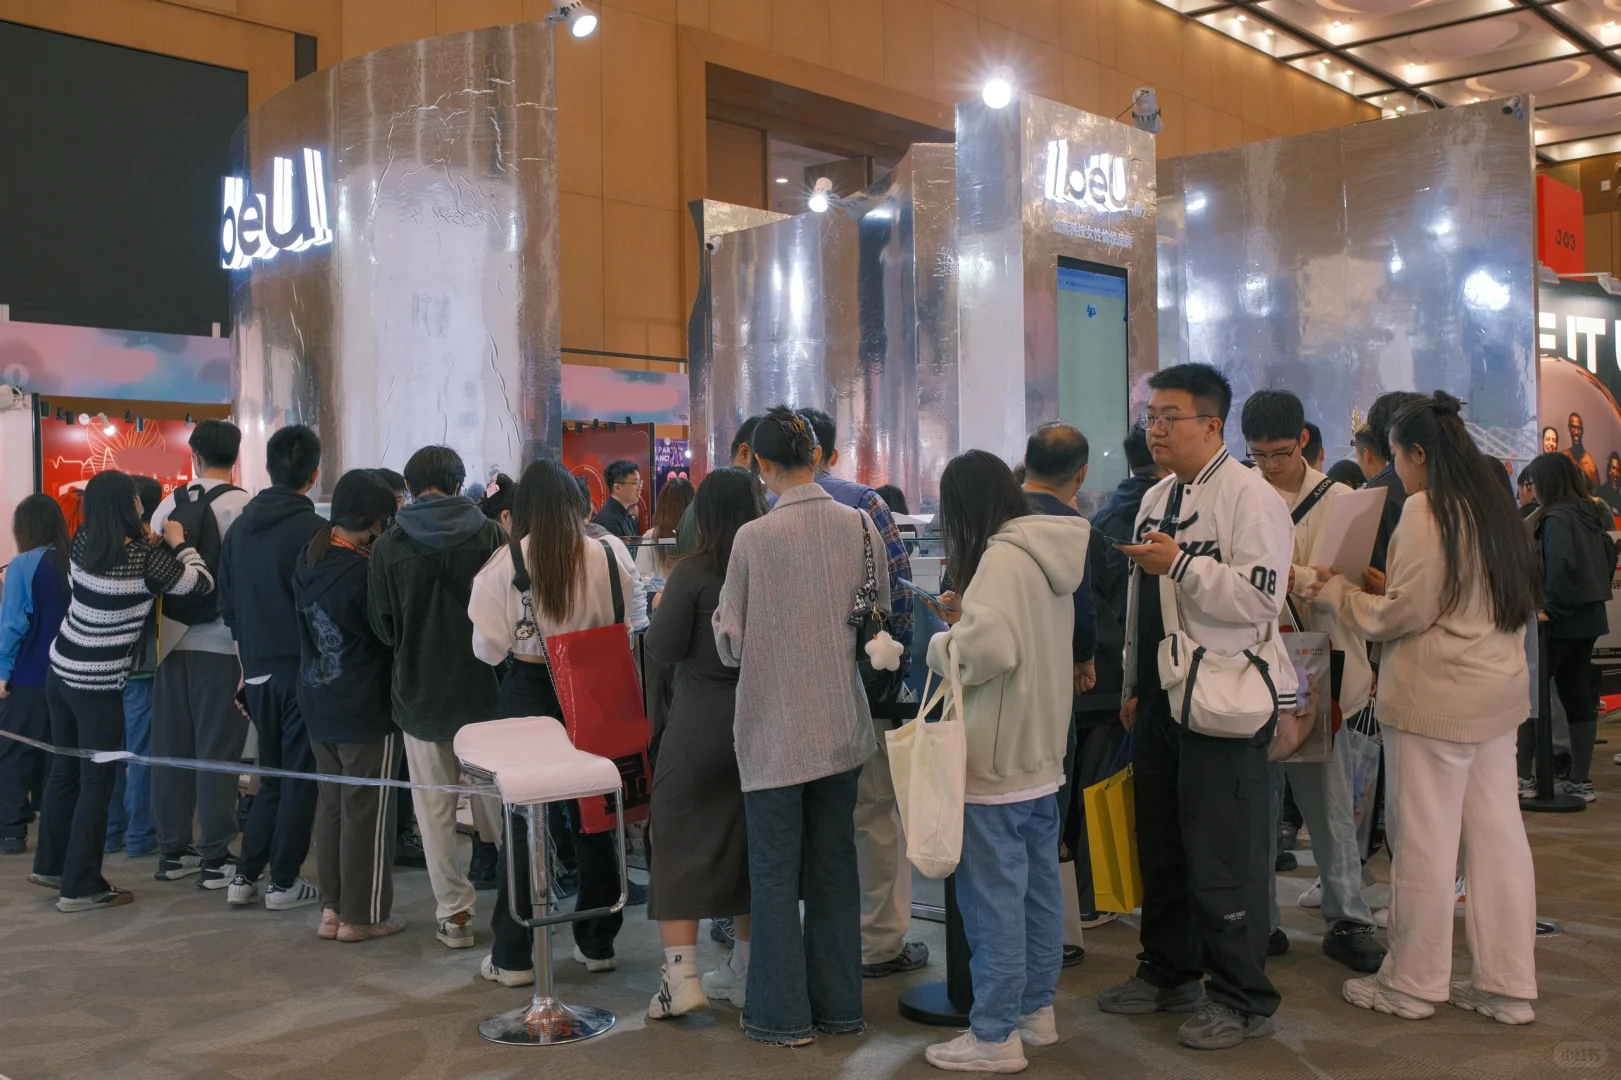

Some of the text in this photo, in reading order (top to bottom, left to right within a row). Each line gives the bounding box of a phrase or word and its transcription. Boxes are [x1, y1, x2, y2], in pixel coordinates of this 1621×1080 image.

[1555, 229, 1577, 251] J03
[1314, 479, 1332, 498] SONY
[1251, 565, 1277, 596] 08
